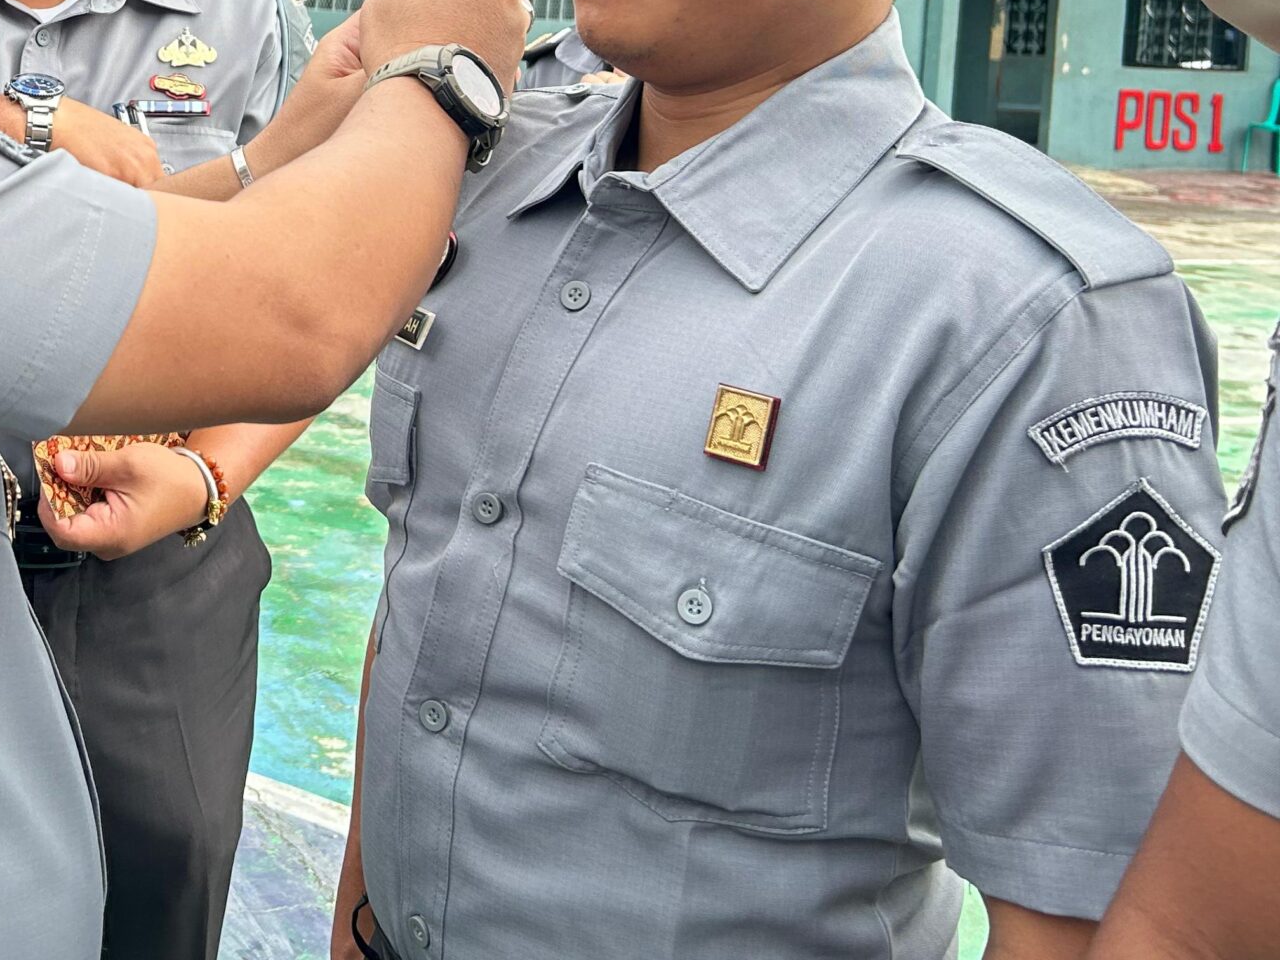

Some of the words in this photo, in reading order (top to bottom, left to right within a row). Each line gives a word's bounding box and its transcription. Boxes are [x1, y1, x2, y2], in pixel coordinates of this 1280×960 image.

[1115, 89, 1200, 152] POS
[1208, 93, 1224, 153] 1
[1042, 400, 1194, 453] KEMENKUMHAM
[1081, 623, 1186, 648] PENGAYOMAN
